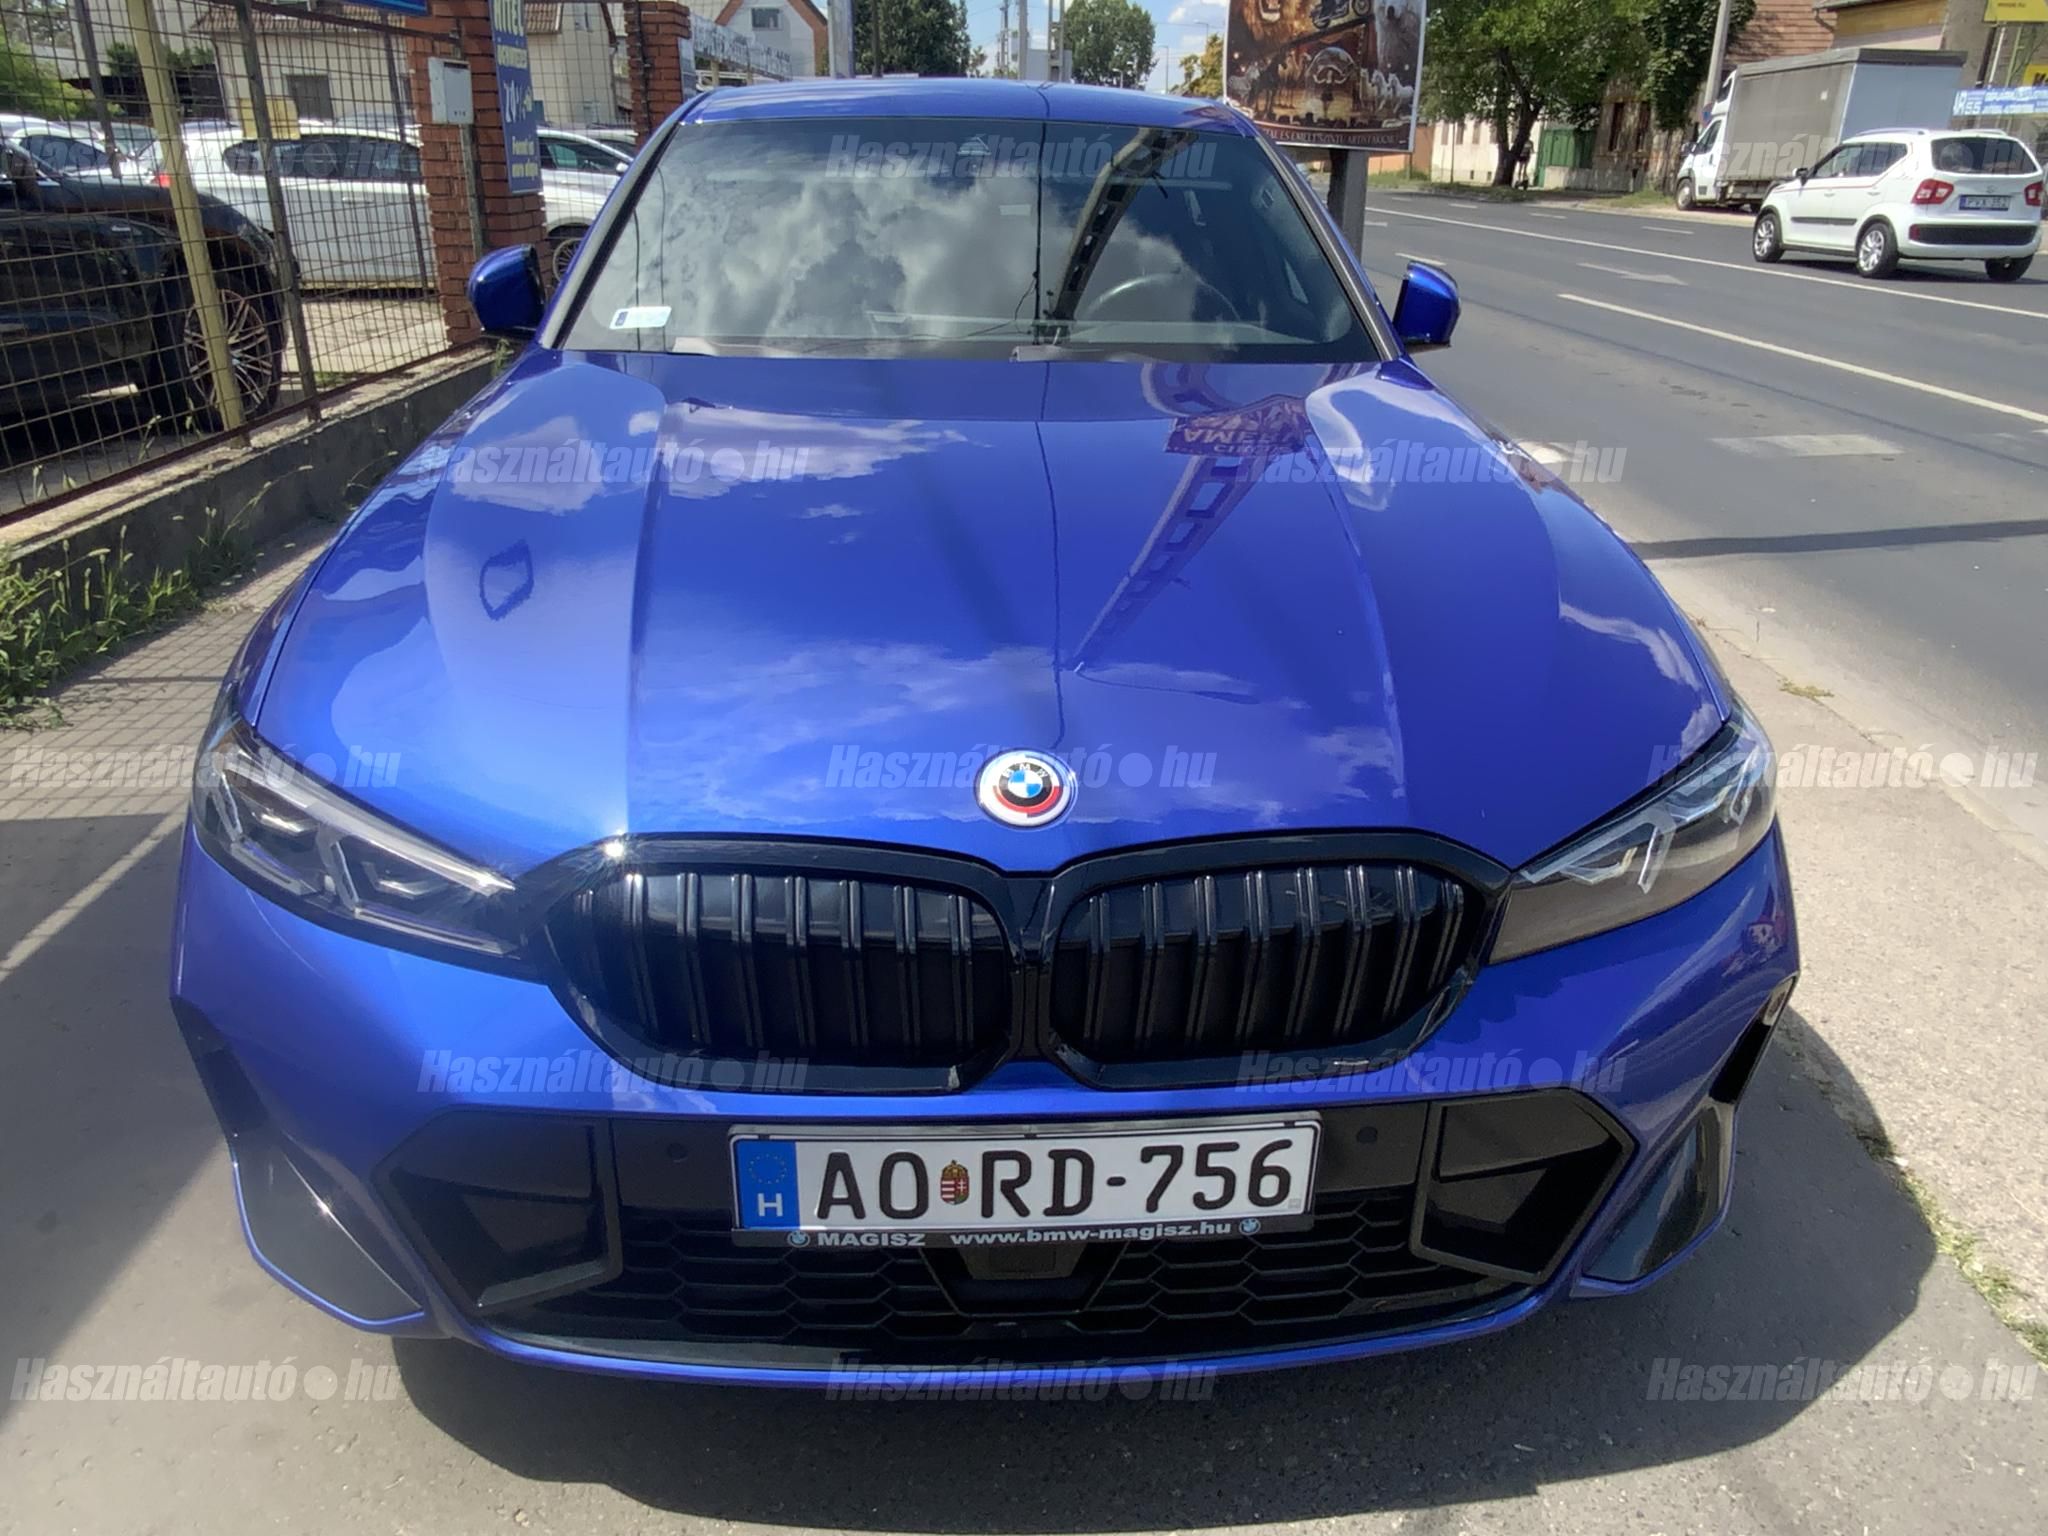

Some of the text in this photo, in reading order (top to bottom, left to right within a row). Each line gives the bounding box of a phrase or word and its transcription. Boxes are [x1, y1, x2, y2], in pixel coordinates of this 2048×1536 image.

[817, 1138, 1294, 1220] AO RD-756
[757, 1193, 783, 1217] H
[818, 1221, 1232, 1247] MAGISZ www.bmw-magisz.hu
